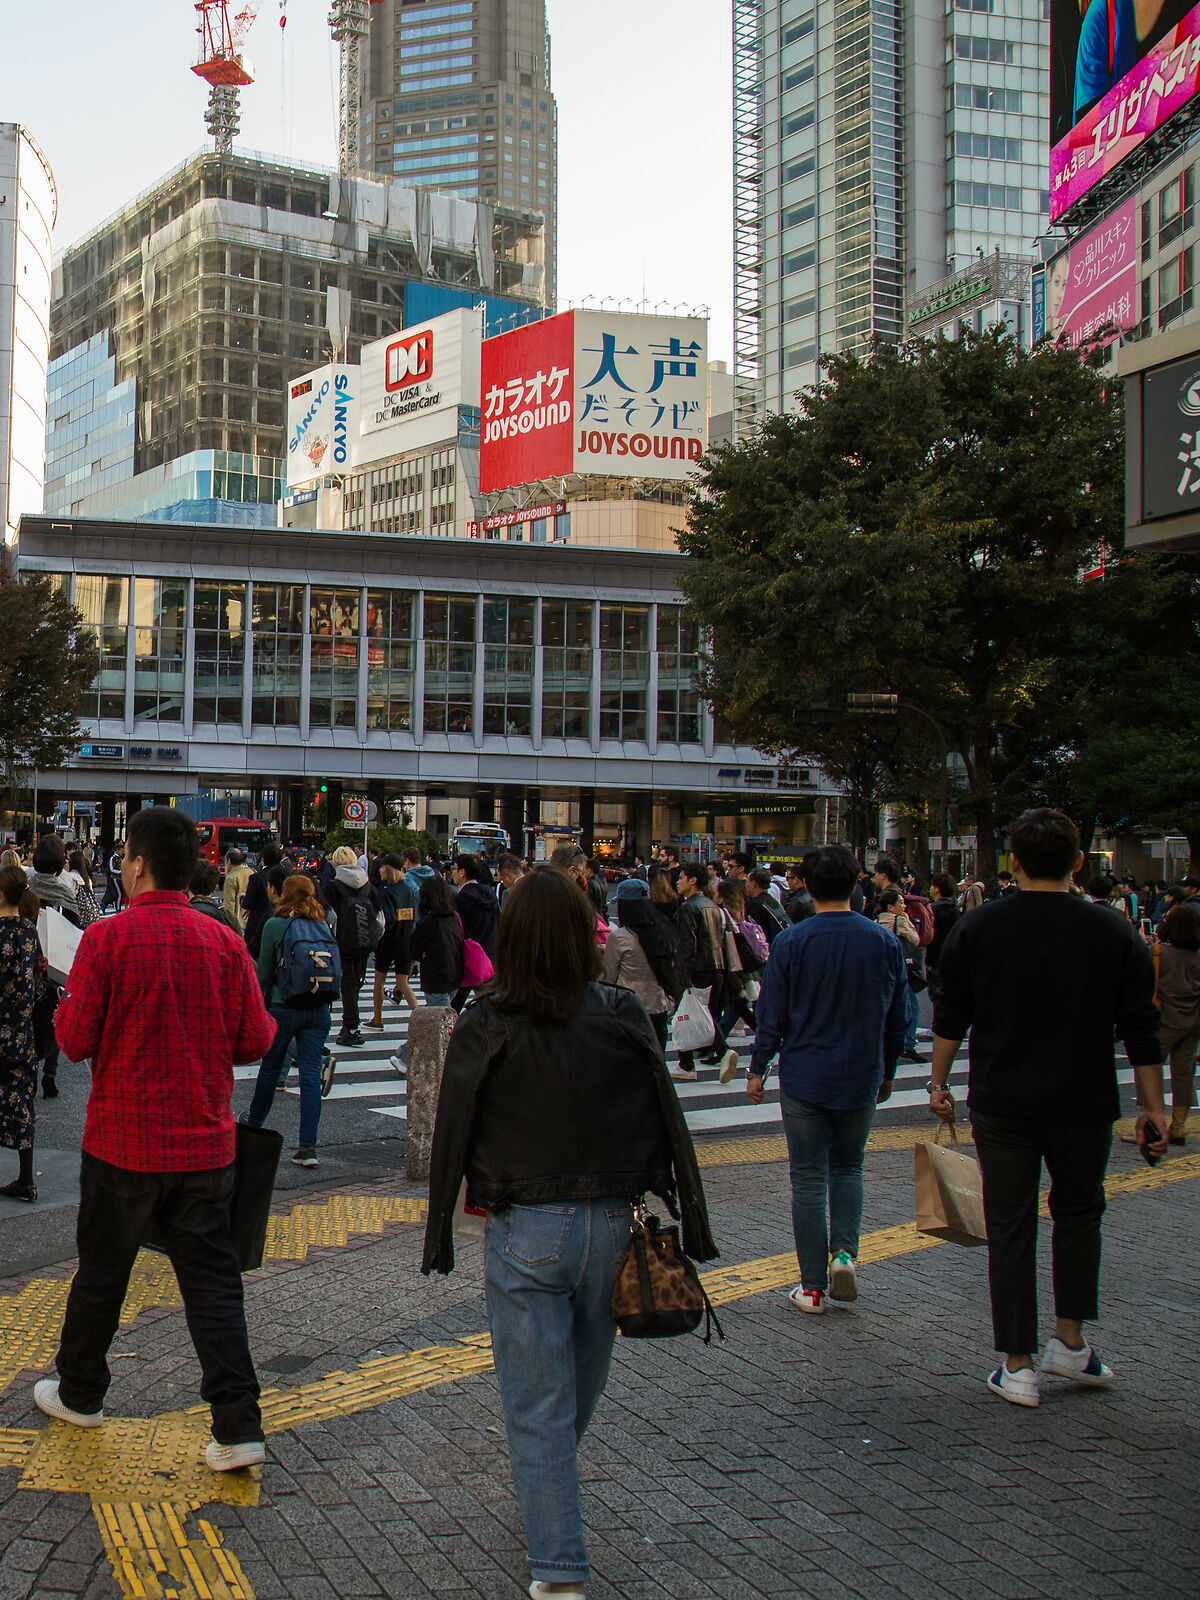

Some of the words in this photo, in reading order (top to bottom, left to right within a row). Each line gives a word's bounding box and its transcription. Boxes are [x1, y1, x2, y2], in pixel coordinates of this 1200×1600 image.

[1085, 216, 1131, 267] 品川スキン
[1086, 242, 1126, 288] クリニック
[908, 297, 949, 321] MARK
[389, 337, 426, 385] DC
[581, 332, 703, 394] 大声
[375, 409, 389, 423] DC
[391, 391, 441, 418] MasterCard
[384, 393, 398, 408] DC
[399, 385, 420, 402] VISA
[485, 366, 569, 419] カラオケ
[579, 393, 703, 434] だそうぜ。
[289, 380, 330, 453] SANKYO
[334, 374, 354, 463] SANKYO
[484, 401, 571, 444] JOYSOUND
[577, 431, 703, 460] JOYSOUND
[487, 513, 515, 528] カラオケ
[516, 506, 551, 521] JOYSOUND
